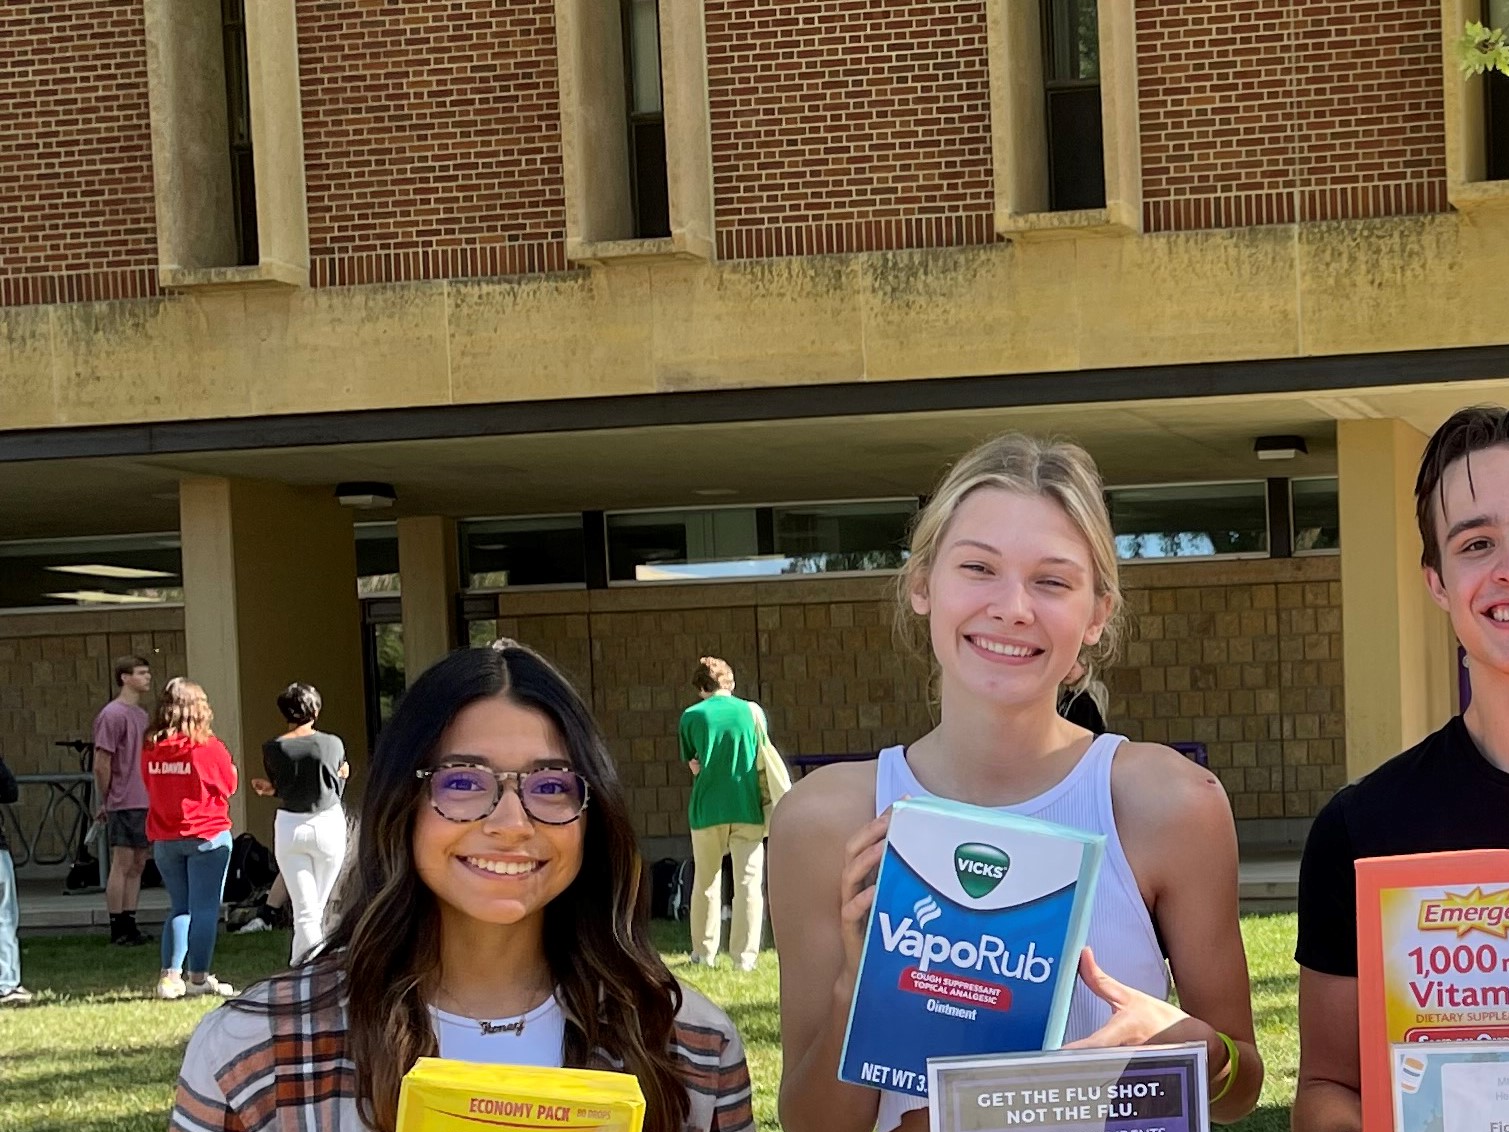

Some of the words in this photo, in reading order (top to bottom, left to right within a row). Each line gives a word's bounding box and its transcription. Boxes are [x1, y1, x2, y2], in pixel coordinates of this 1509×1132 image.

[958, 858, 1004, 879] VICKS
[878, 912, 1051, 983] VapoRub
[1408, 944, 1497, 979] 1,000
[910, 971, 942, 984] COUGH
[943, 978, 1002, 996] SUPPRESSANT
[914, 980, 948, 996] TOPICAL
[950, 987, 998, 1004] ANALGESIC
[926, 998, 977, 1020] Ointment
[1416, 1011, 1464, 1024] DIETARY
[861, 1062, 890, 1084] NET
[892, 1068, 916, 1090] WT
[977, 1091, 1016, 1108] GET
[1020, 1089, 1060, 1104] THE
[1066, 1086, 1100, 1102] FLU
[1107, 1082, 1165, 1099] SHOT.
[469, 1098, 534, 1119] ECONOMY
[536, 1104, 571, 1122] PACK
[1007, 1108, 1048, 1124] NOT
[1053, 1106, 1092, 1121] THE
[1098, 1103, 1138, 1118] FLU.
